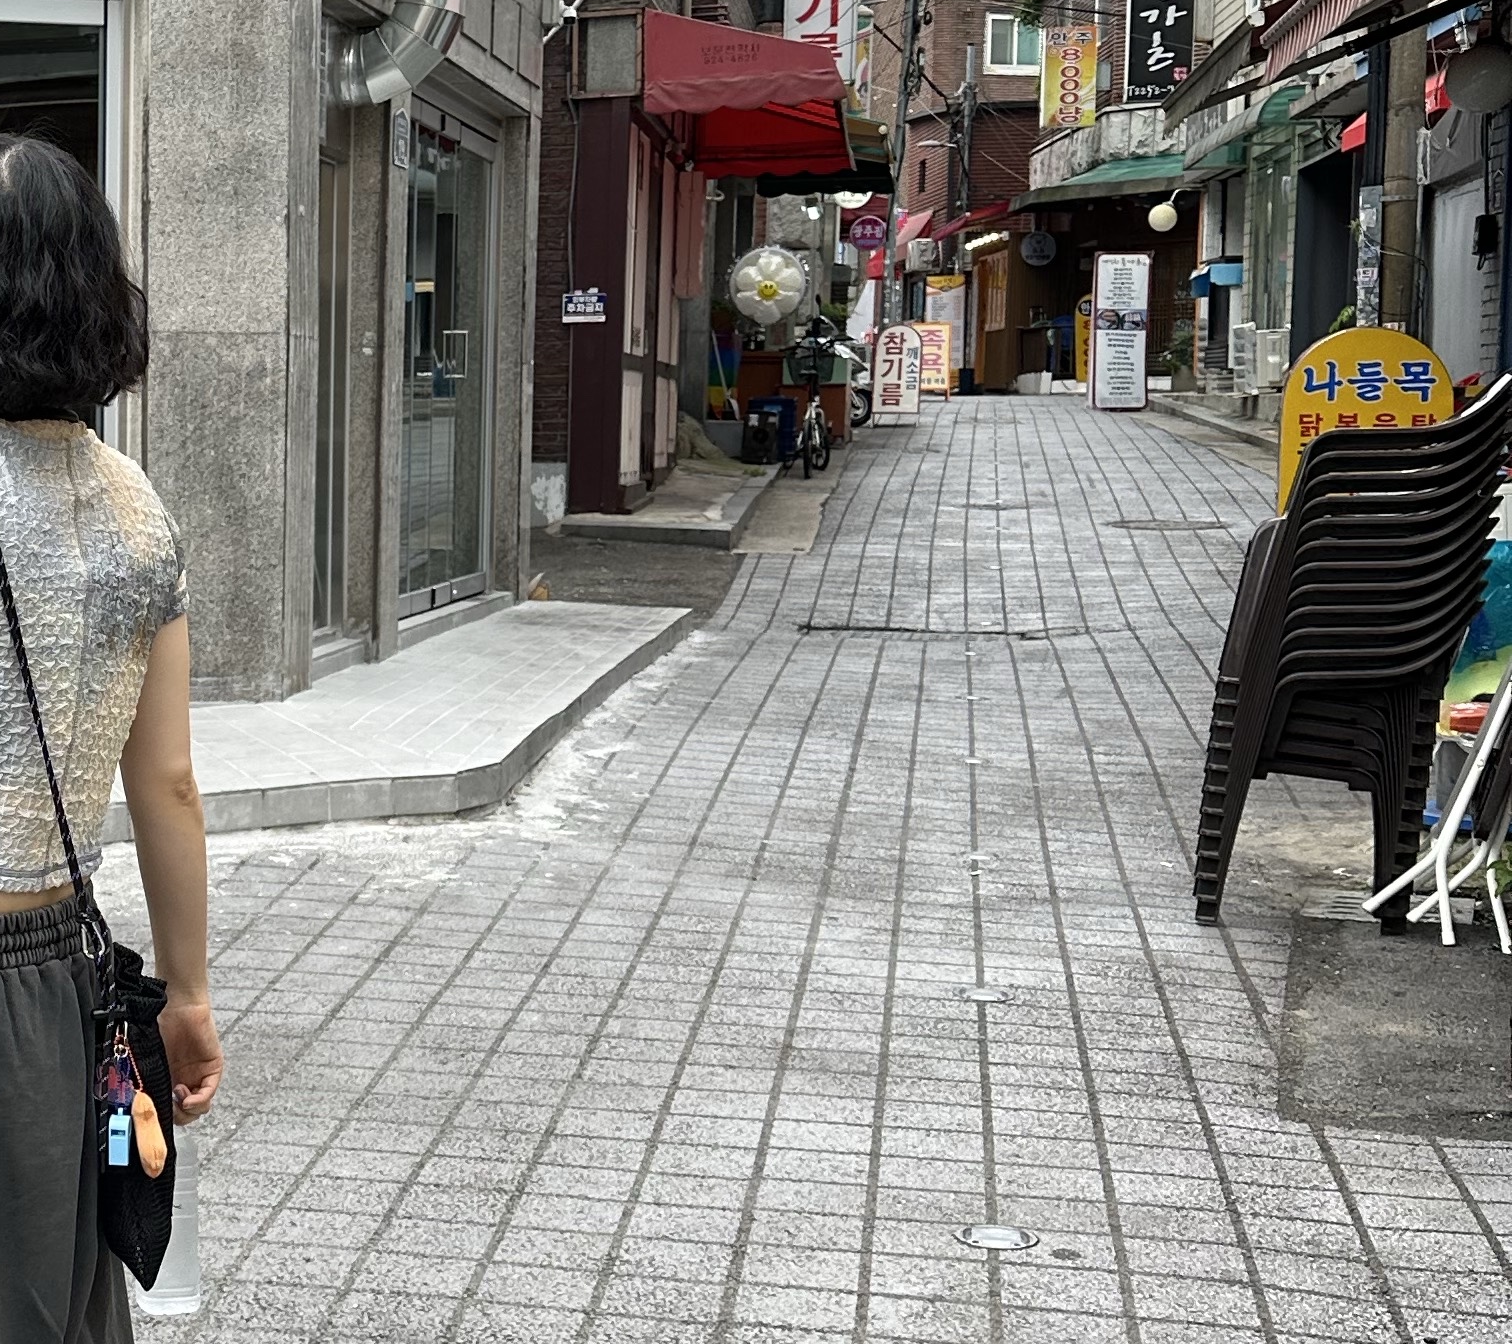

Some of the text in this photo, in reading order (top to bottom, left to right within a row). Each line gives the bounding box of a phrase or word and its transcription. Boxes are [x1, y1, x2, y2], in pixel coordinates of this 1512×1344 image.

[567, 302, 604, 313] 주차금지
[880, 332, 908, 407] 참기름
[1302, 359, 1440, 403] 나들목
